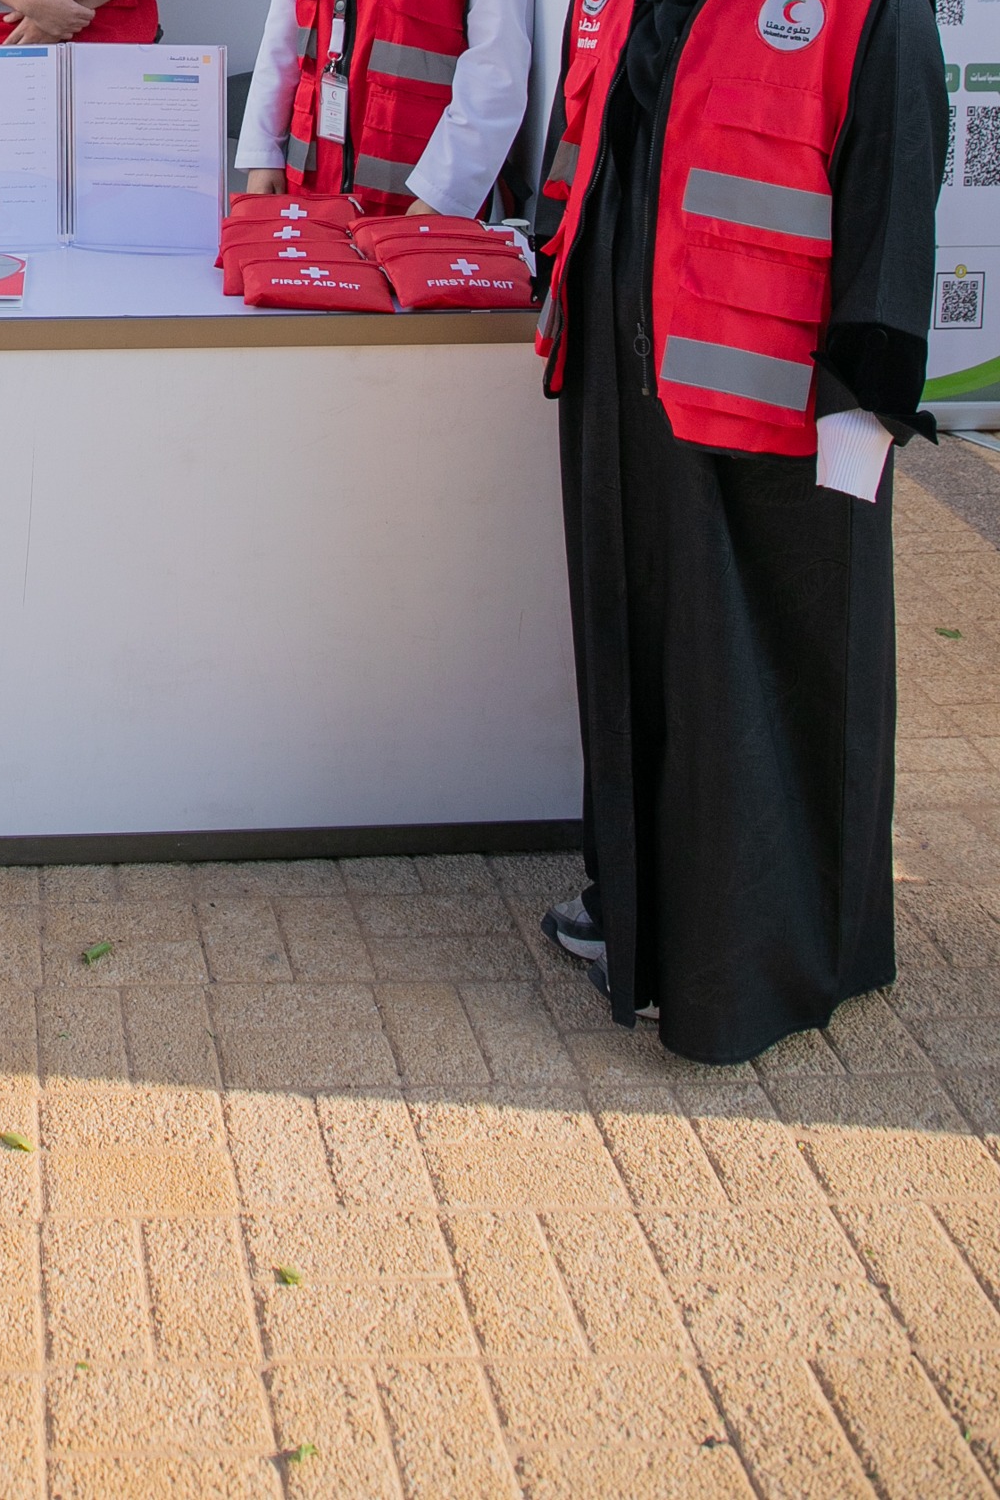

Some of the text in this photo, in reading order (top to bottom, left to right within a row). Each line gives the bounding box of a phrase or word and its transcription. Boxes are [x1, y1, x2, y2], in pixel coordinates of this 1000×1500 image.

[271, 278, 361, 291] FIRST AID KIT
[427, 278, 515, 290] FIRST AID KIT
